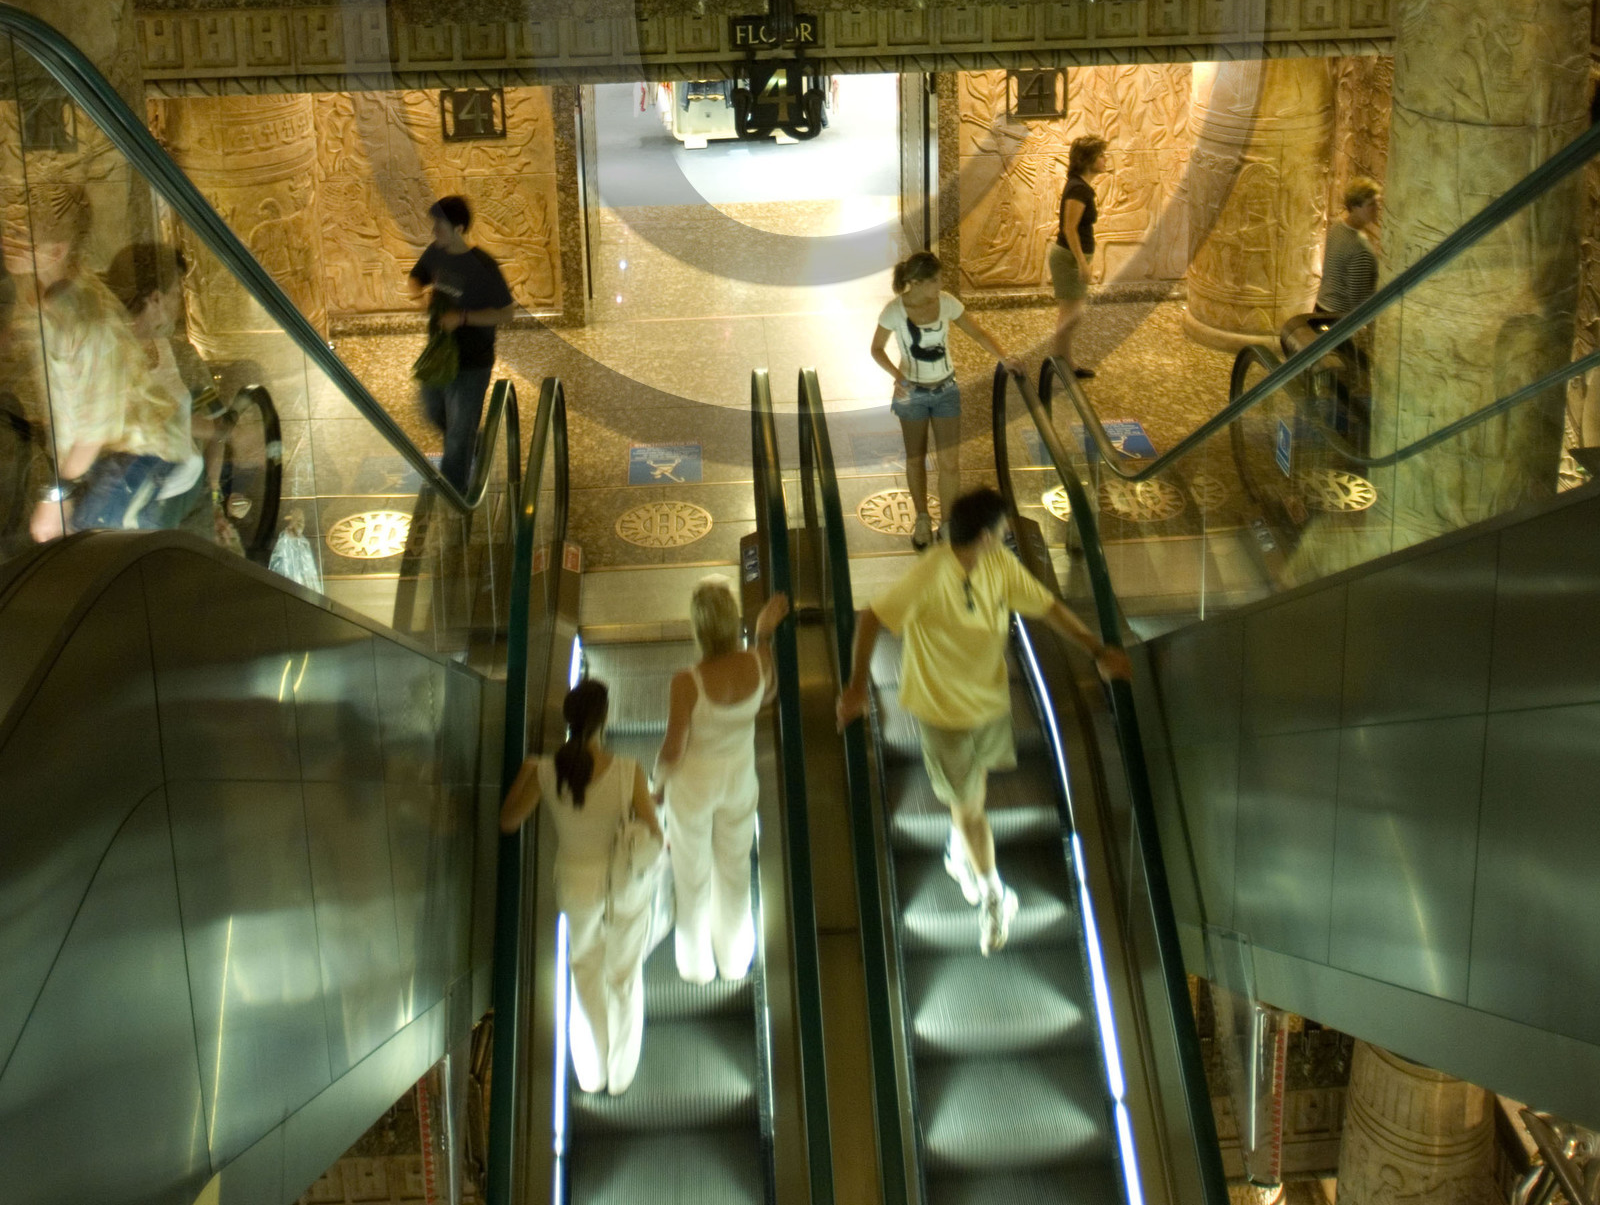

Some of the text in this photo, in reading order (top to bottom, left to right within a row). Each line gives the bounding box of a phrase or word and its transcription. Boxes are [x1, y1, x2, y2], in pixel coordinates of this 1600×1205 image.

[757, 68, 796, 122] 4
[1021, 72, 1051, 112] 4
[458, 93, 489, 133] 4
